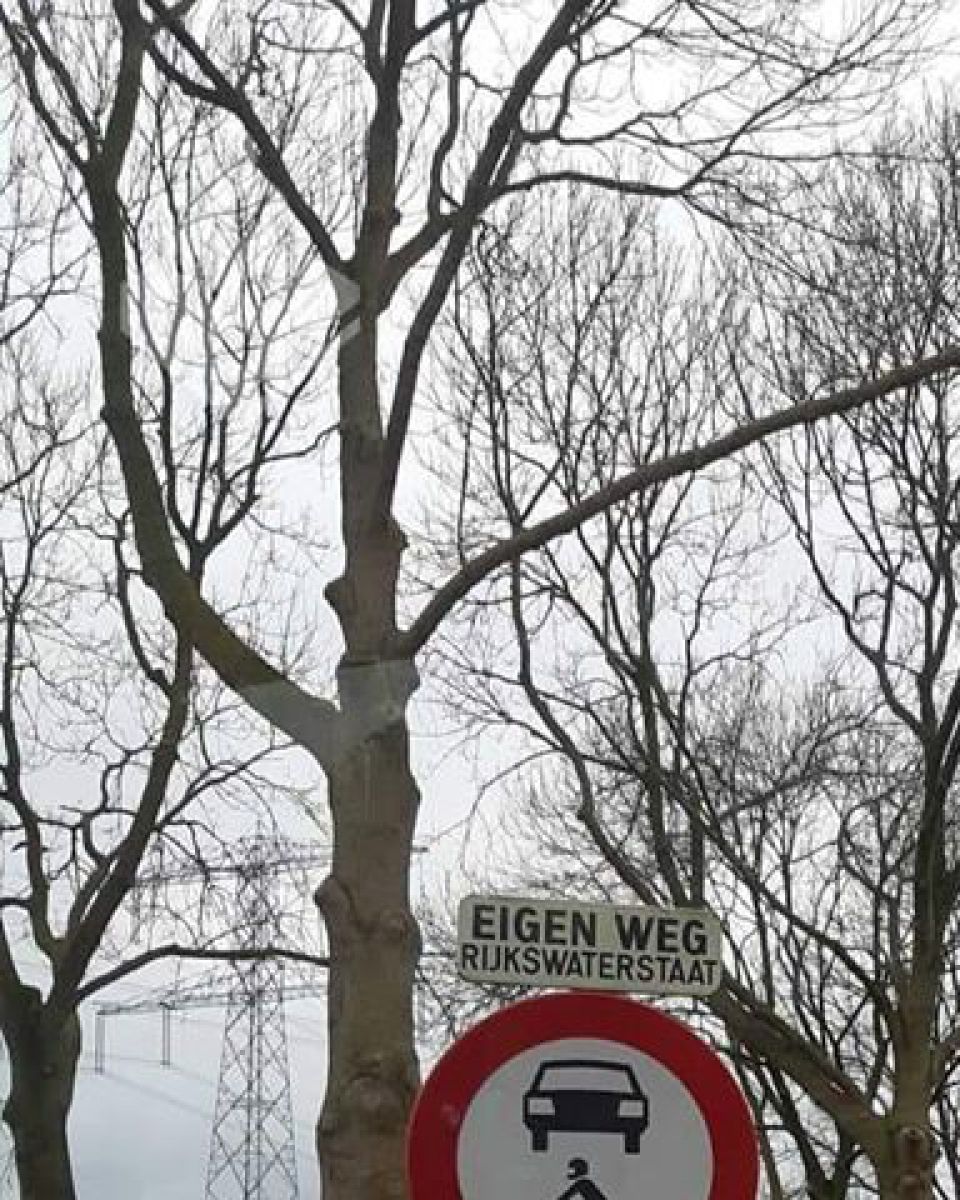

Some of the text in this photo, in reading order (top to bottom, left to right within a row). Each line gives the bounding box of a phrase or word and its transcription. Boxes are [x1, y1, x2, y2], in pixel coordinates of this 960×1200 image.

[472, 904, 708, 956] EIGEN WEG
[461, 943, 718, 985] RIJKSWATERSTAAT
